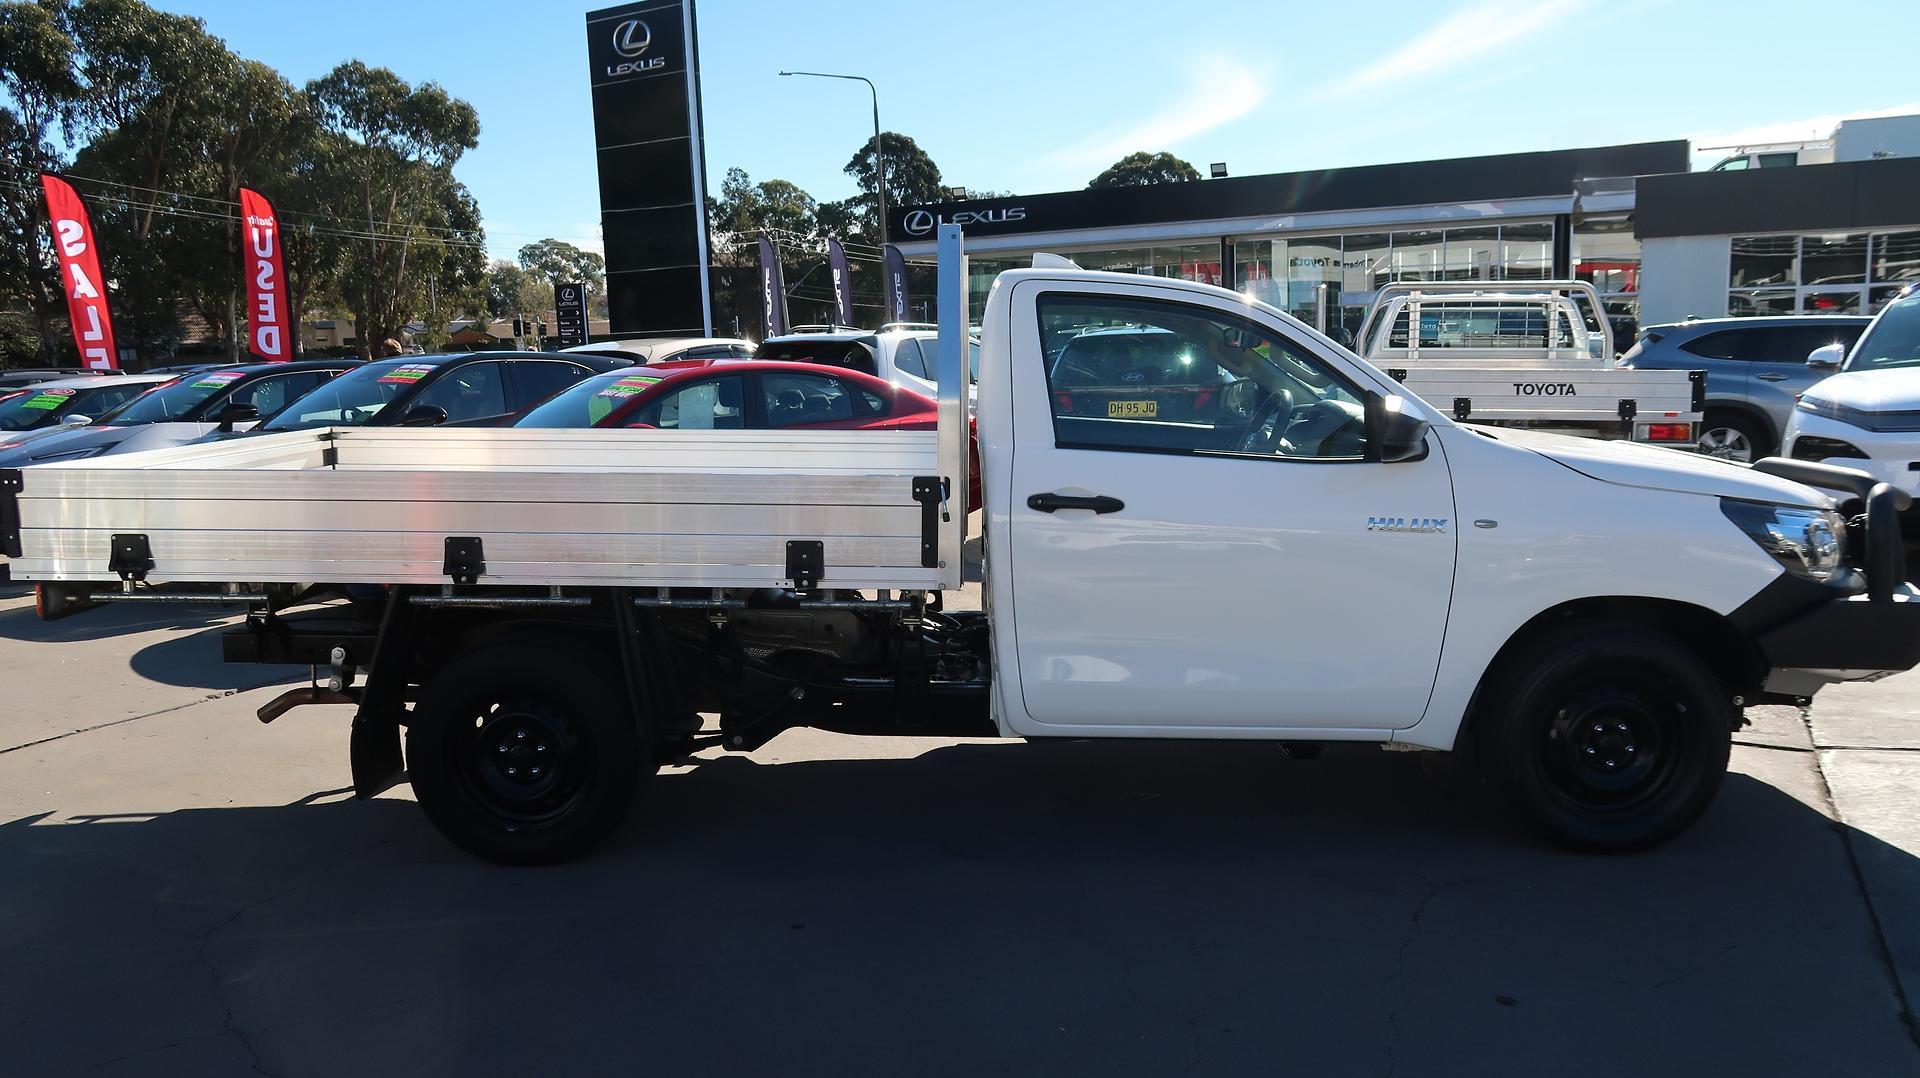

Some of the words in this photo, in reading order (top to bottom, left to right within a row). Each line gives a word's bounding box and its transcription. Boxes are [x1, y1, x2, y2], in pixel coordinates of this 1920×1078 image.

[607, 57, 665, 76] LEXUS
[938, 205, 1026, 224] LEXUS
[1513, 384, 1576, 395] TOYOTA
[1110, 403, 1123, 413] DH
[1126, 403, 1139, 413] 95
[1367, 517, 1448, 533] HILUX
